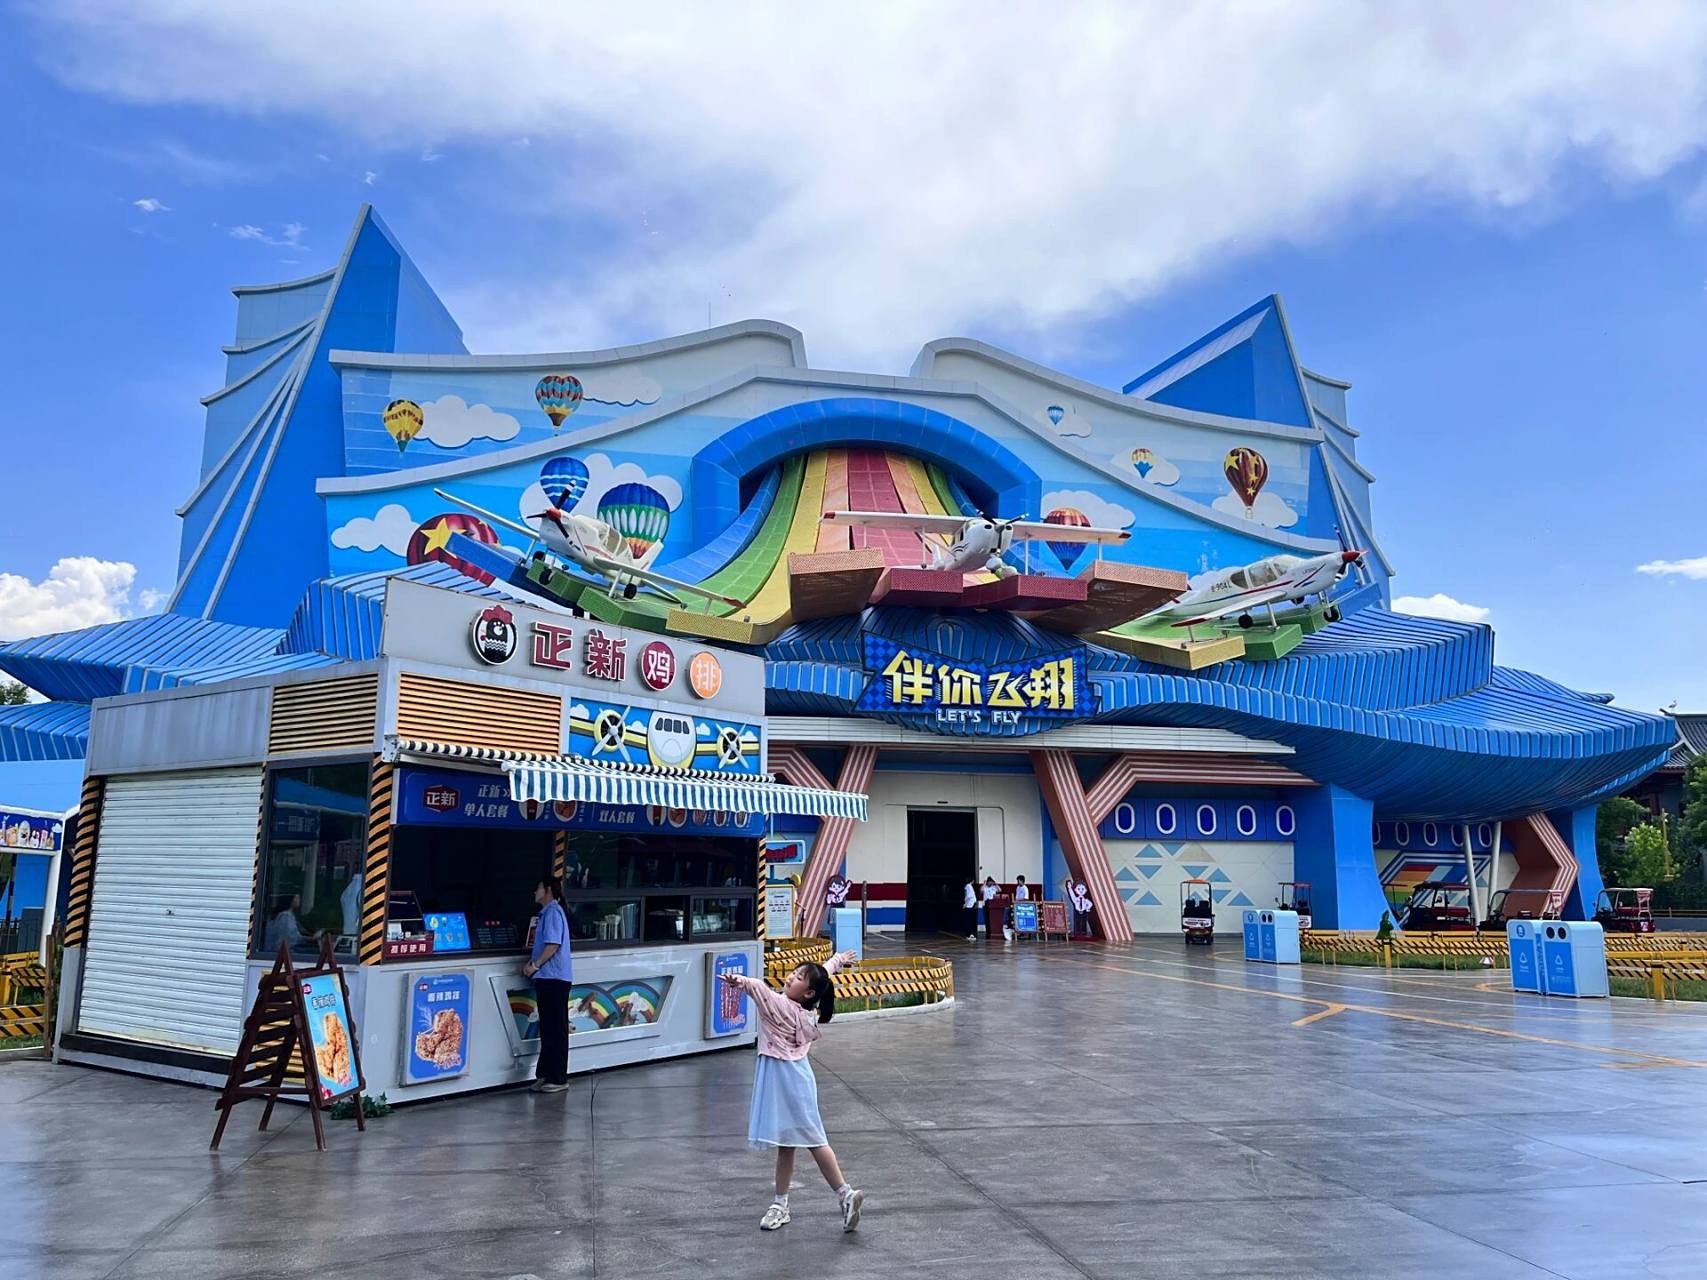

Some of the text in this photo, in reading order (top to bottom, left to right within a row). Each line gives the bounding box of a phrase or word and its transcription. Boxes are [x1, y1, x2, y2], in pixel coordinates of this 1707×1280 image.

[531, 622, 718, 694] 正新鸡排
[882, 650, 1076, 711] 伴你飞翔
[936, 708, 1021, 725] LET'S FLY
[427, 791, 456, 807] 正新
[464, 803, 509, 818] 单人套餐
[599, 810, 635, 824] 双人套餐
